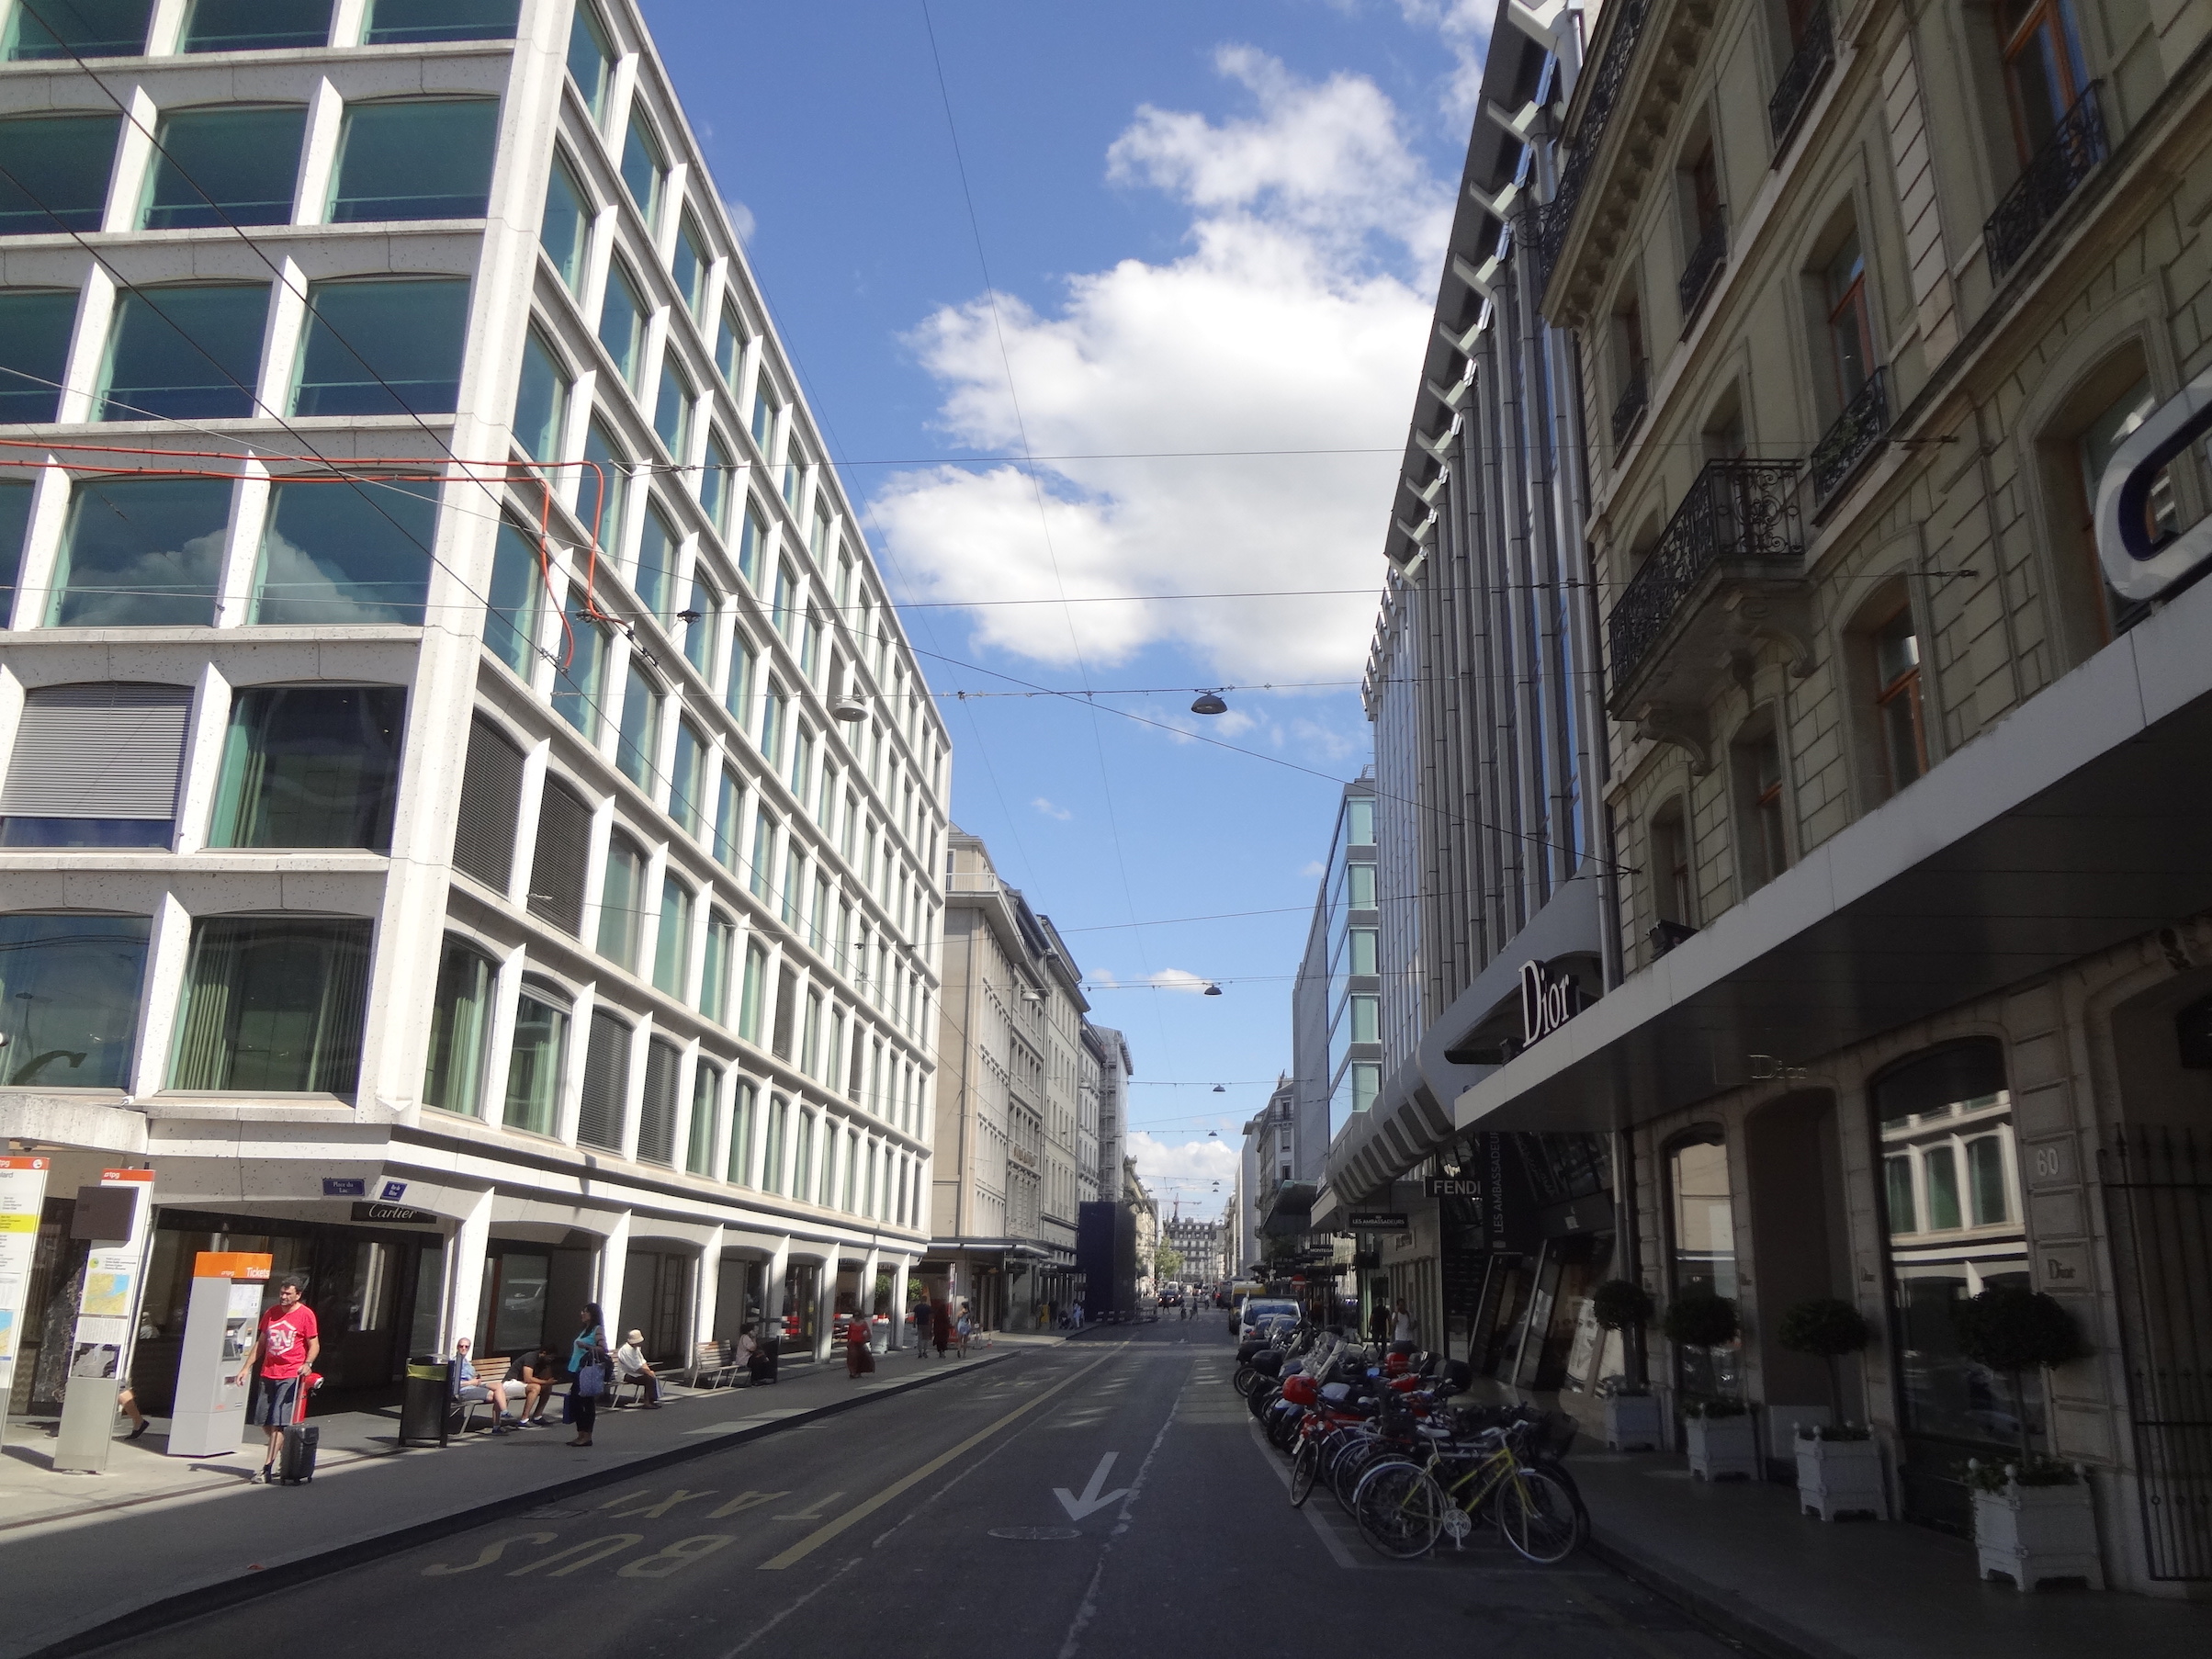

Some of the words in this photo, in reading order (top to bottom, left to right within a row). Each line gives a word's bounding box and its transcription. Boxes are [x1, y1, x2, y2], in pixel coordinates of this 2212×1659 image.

[1518, 959, 1570, 1048] Dior
[1747, 1054, 1809, 1079] Dior
[2036, 1147, 2059, 1177] 60
[1433, 1179, 1482, 1195] FENDI
[368, 1203, 418, 1219] Cartier
[1492, 1213, 1505, 1234] LES
[246, 1267, 270, 1278] Tickets
[2047, 1258, 2076, 1280] Dior
[598, 1489, 846, 1520] TAXI
[420, 1531, 739, 1578] BUS
